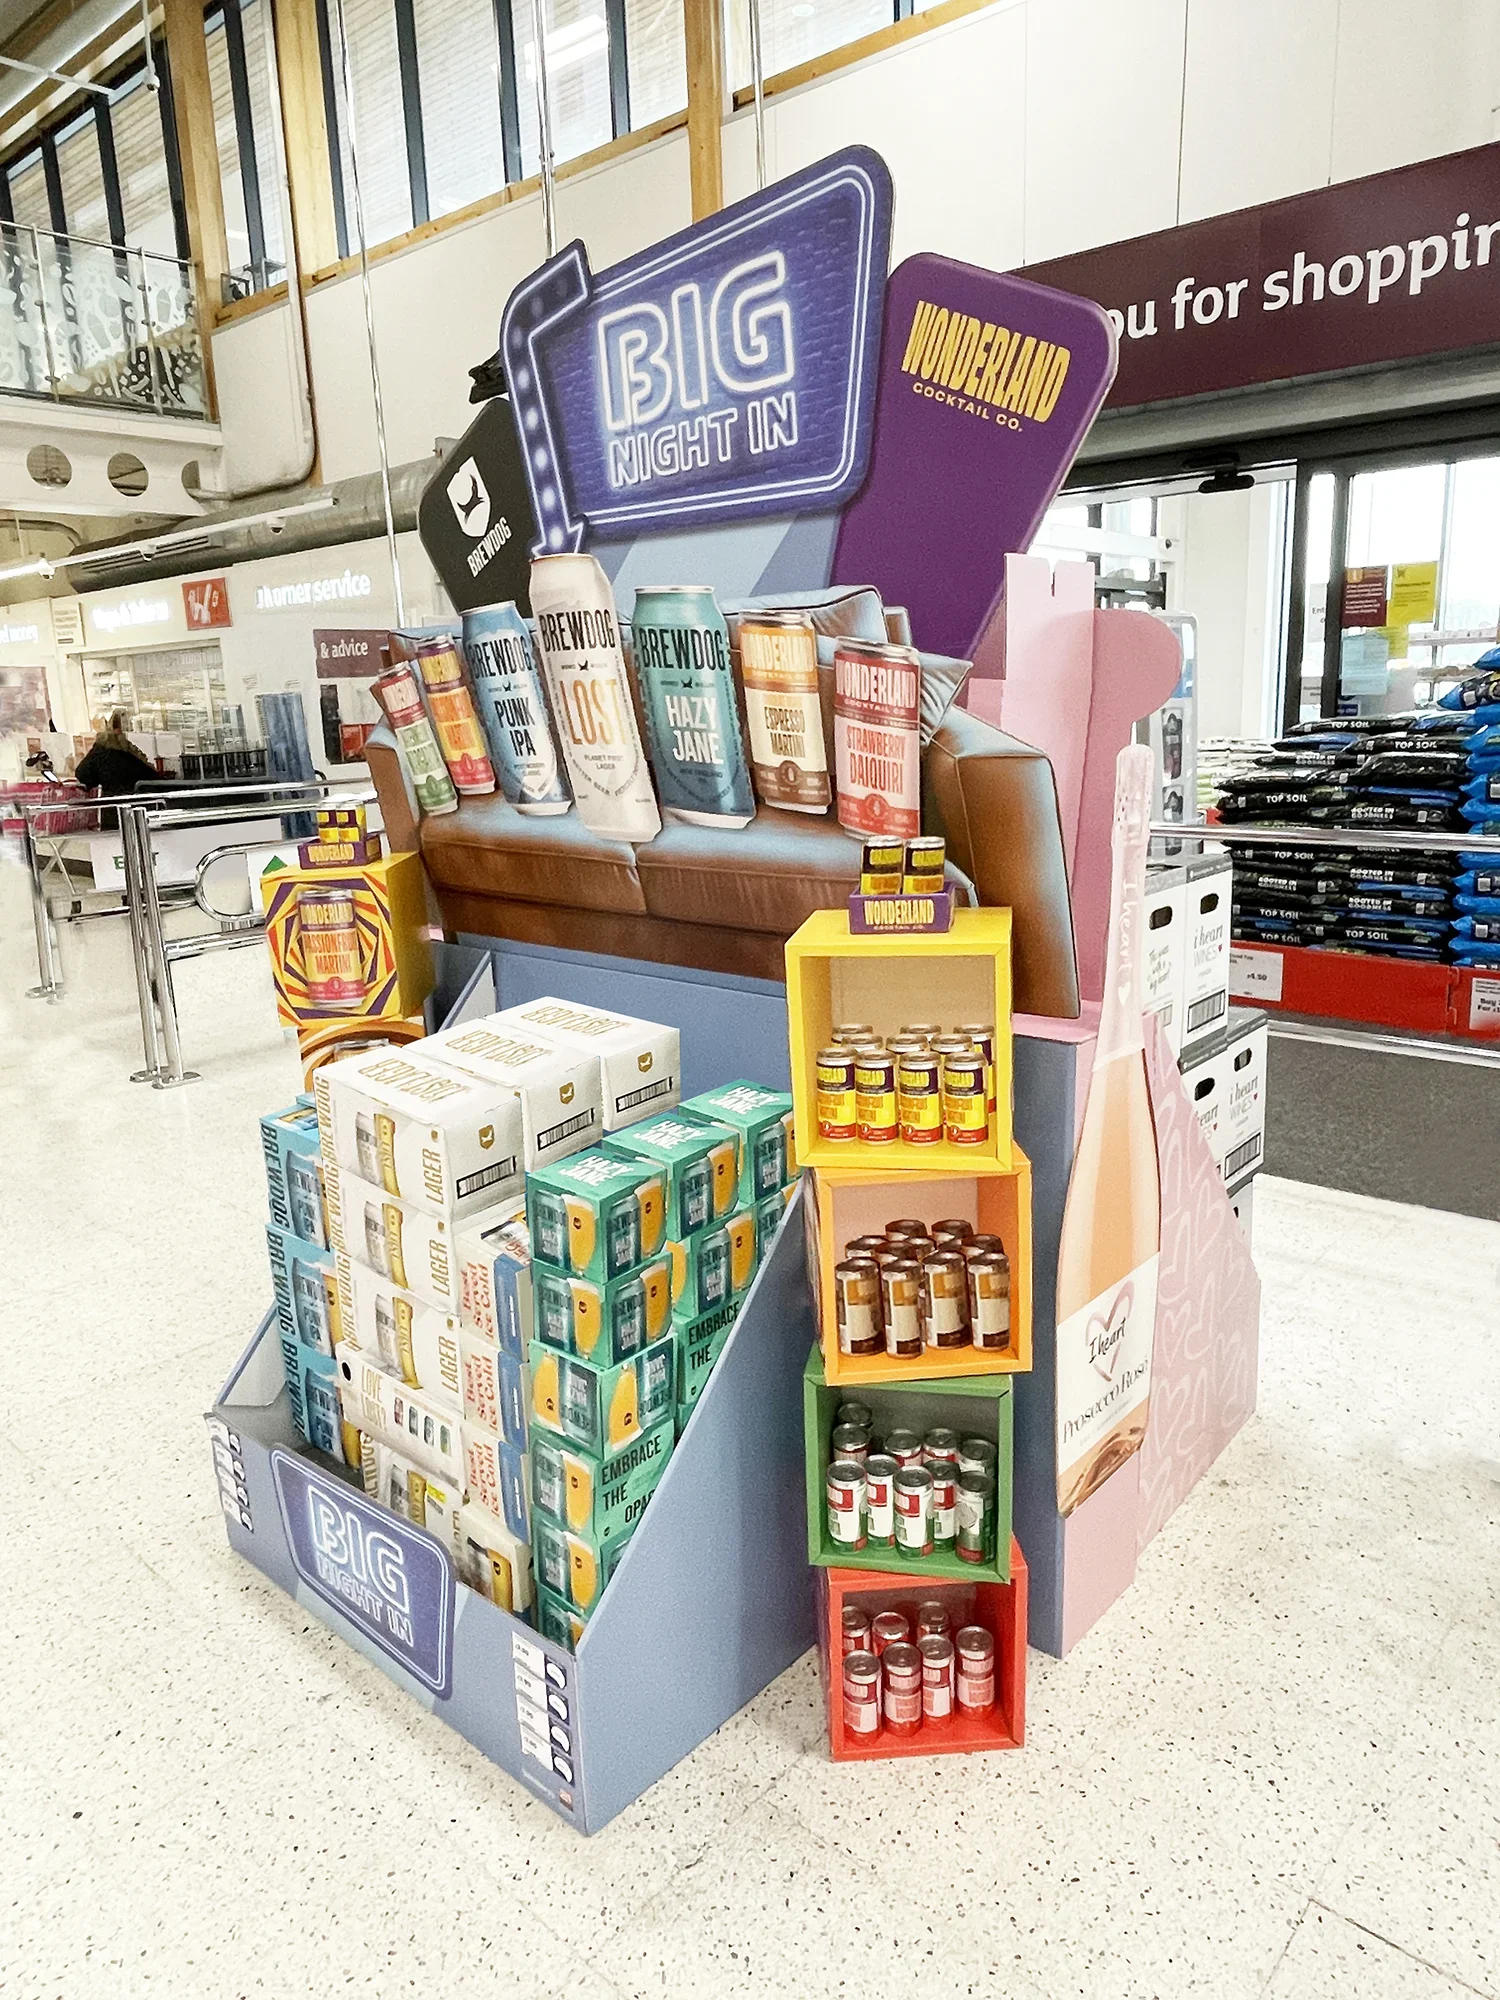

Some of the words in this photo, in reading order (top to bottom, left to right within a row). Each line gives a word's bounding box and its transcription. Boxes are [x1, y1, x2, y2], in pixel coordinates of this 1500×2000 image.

[1107, 299, 1158, 341] ou
[1170, 277, 1249, 330] for
[598, 249, 796, 432] BIG
[901, 300, 1071, 424] WONDERLAND
[912, 382, 991, 420] COCKTAIL
[995, 413, 1024, 433] CO.
[608, 407, 738, 489] NIGHT
[748, 391, 799, 455] IN
[467, 517, 512, 577] BREWDOG
[313, 569, 371, 602] service
[320, 641, 330, 659] &
[331, 638, 369, 658] advice
[538, 608, 616, 653] BREWDOG
[638, 627, 727, 672] BREWDOG
[468, 635, 533, 680] BREWDOG
[836, 658, 918, 710] WONDERLAND
[844, 698, 892, 713] COCKTAIL
[493, 696, 536, 729] PUNK
[559, 678, 628, 746] LOST
[664, 694, 718, 731] HAZY
[764, 706, 806, 734] ESPRESSO
[1331, 721, 1347, 729] TOP
[1350, 720, 1370, 728] SOIL
[509, 728, 537, 757] IPA
[672, 729, 725, 766] JANE
[846, 725, 908, 761] STRAWBERRY
[1395, 741, 1413, 749] TOP
[1415, 740, 1437, 749] SOIL
[850, 752, 905, 795] DAIQUIRI
[1266, 795, 1284, 803] TOP
[1286, 794, 1308, 802] SOIL
[1274, 851, 1292, 859] TOP
[1294, 852, 1315, 860] SOIL
[864, 899, 935, 925] WONDERLAND
[1260, 908, 1277, 917] TOP
[1279, 910, 1300, 920] SOIL
[1117, 901, 1138, 973] heart
[1261, 932, 1279, 941] TOP
[1281, 933, 1302, 943] SOIL
[1345, 929, 1363, 939] TOP
[1367, 931, 1389, 940] SOIL
[708, 1097, 759, 1115] JANE
[726, 1086, 781, 1105] HAZY
[1196, 1104, 1219, 1127] eart
[632, 1132, 687, 1150] JANE
[651, 1120, 707, 1140] HAZY
[261, 1122, 291, 1229] BREWDOG
[422, 1147, 444, 1205] LAGER
[558, 1168, 614, 1187] JANE
[577, 1155, 635, 1177] HAZY
[266, 1230, 297, 1336] BREWDOG
[429, 1239, 451, 1297] LAGER
[478, 1262, 491, 1309] Cold
[688, 1300, 741, 1347] EMBRACE
[1089, 1337, 1098, 1364] I
[1097, 1317, 1127, 1357] heart
[439, 1335, 459, 1394] LAGER
[481, 1355, 495, 1402] Cold
[690, 1348, 713, 1370] THE
[1062, 1383, 1120, 1444] Prosecco
[483, 1443, 497, 1488] Cold
[601, 1434, 662, 1486] EMBRACE
[602, 1480, 628, 1512] THE
[308, 1484, 410, 1614] BIG
[316, 1551, 383, 1623] NIGHT
[386, 1605, 414, 1648] IN
